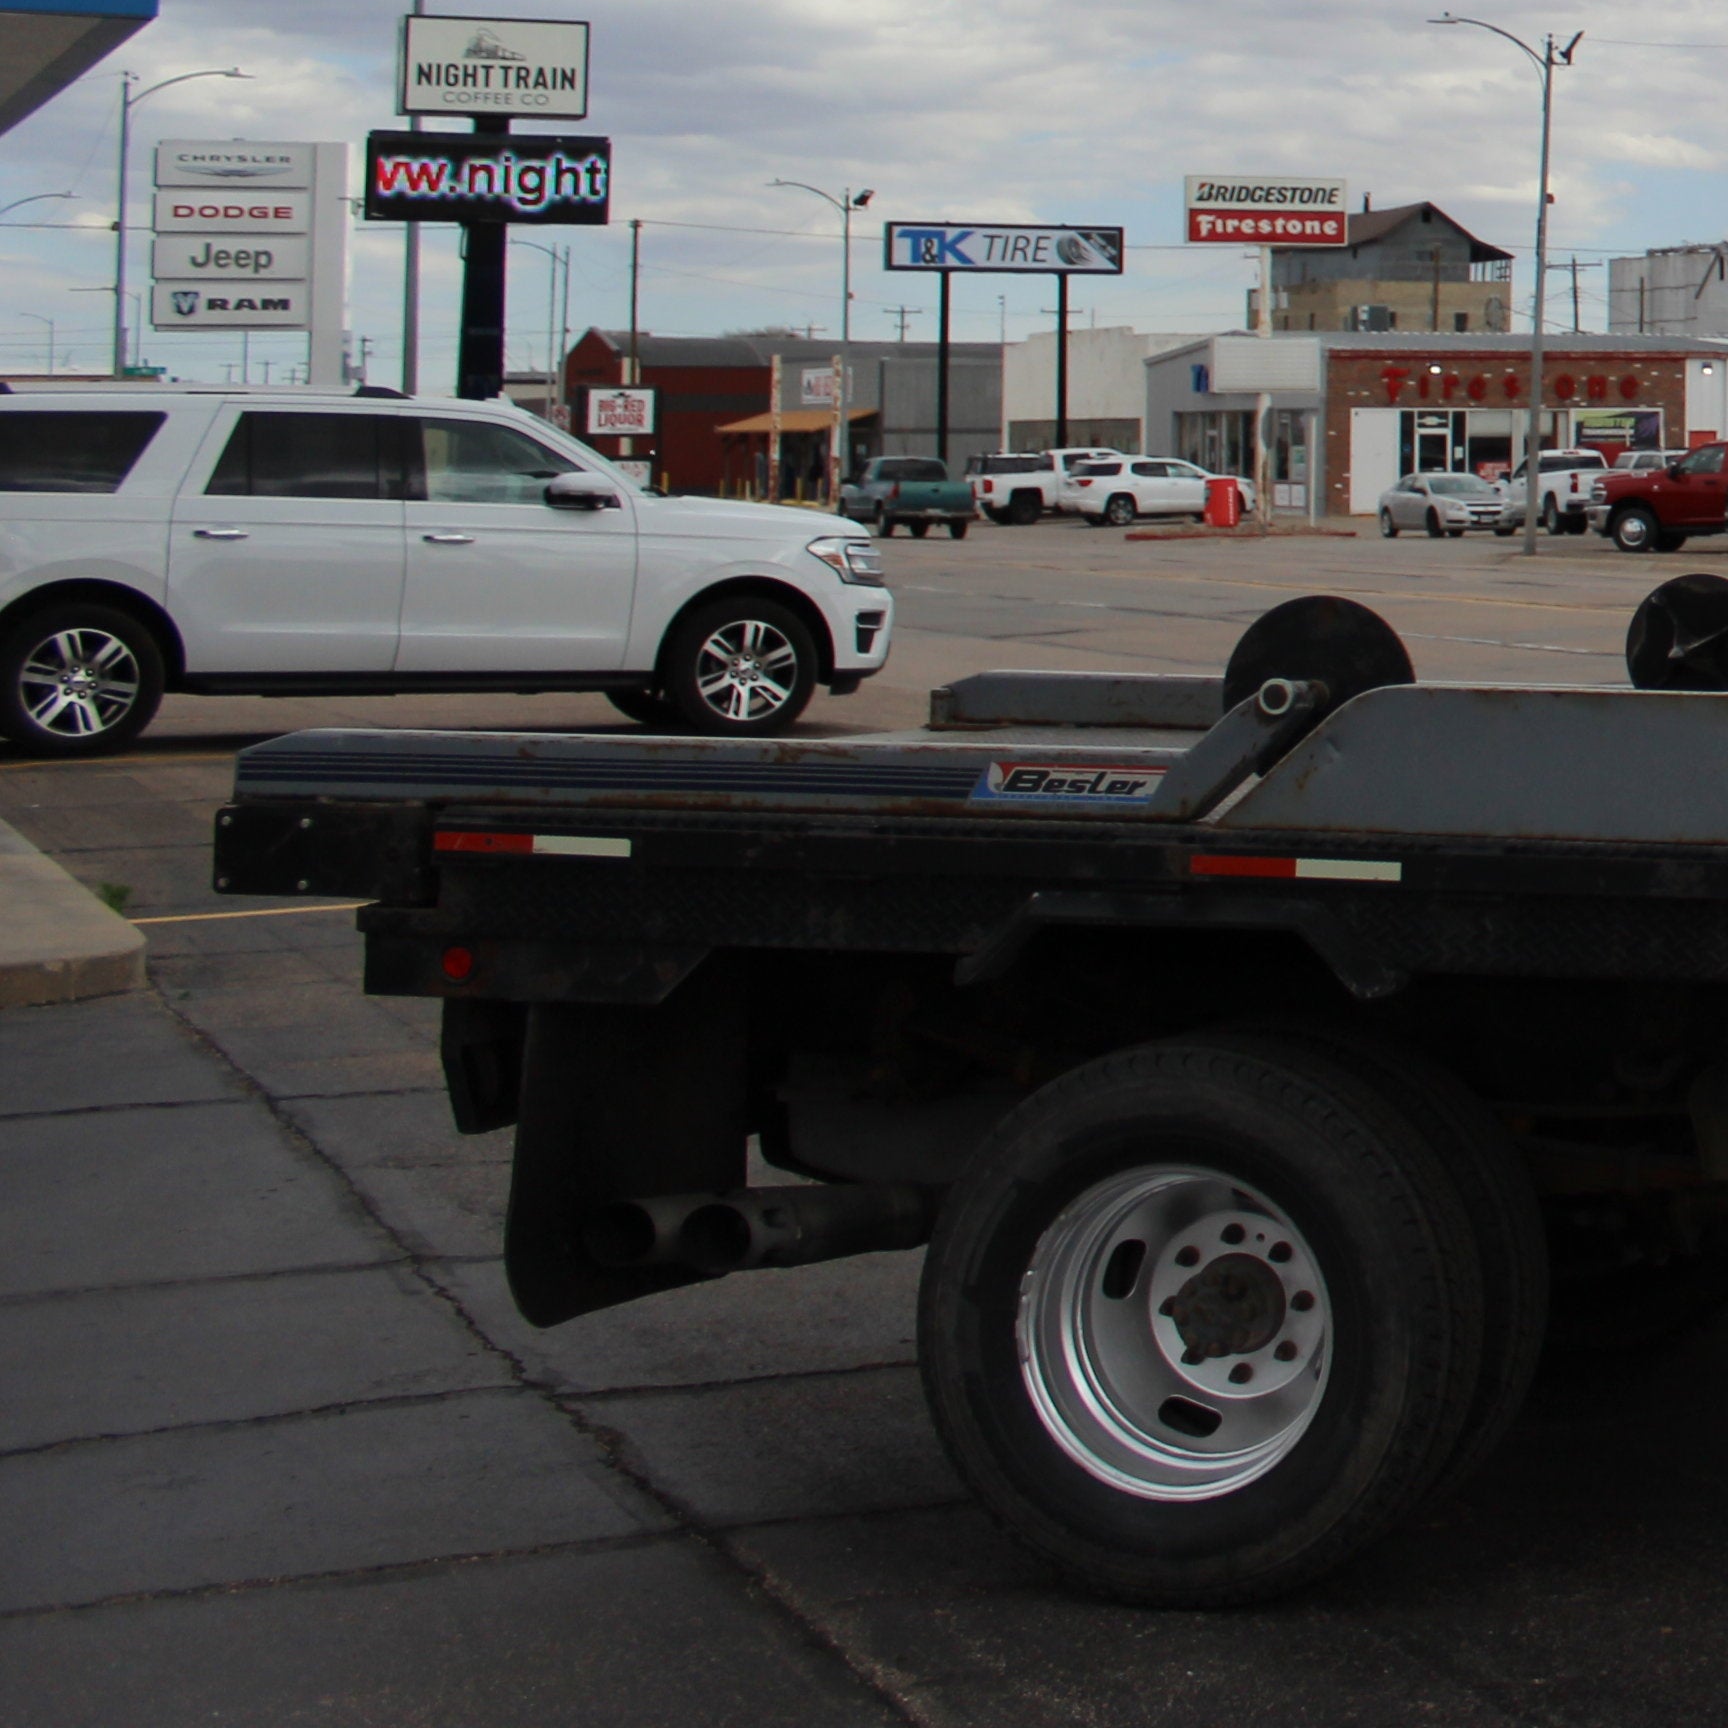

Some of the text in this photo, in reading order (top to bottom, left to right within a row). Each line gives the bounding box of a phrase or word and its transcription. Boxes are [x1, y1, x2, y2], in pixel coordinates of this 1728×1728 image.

[417, 63, 576, 90] NIGHT TRAIN
[443, 91, 549, 106] COFFEE CO
[178, 154, 292, 164] CHRYSLER
[1197, 183, 1340, 205] BRIDGESTONE
[172, 205, 294, 219] DODGE
[1197, 214, 1339, 238] Firestone
[190, 243, 273, 273] Jeep
[897, 229, 1051, 265] T&K TIRE
[206, 298, 291, 311] RAM
[1379, 367, 1640, 404] Firesone
[1002, 769, 1147, 796] Besler
